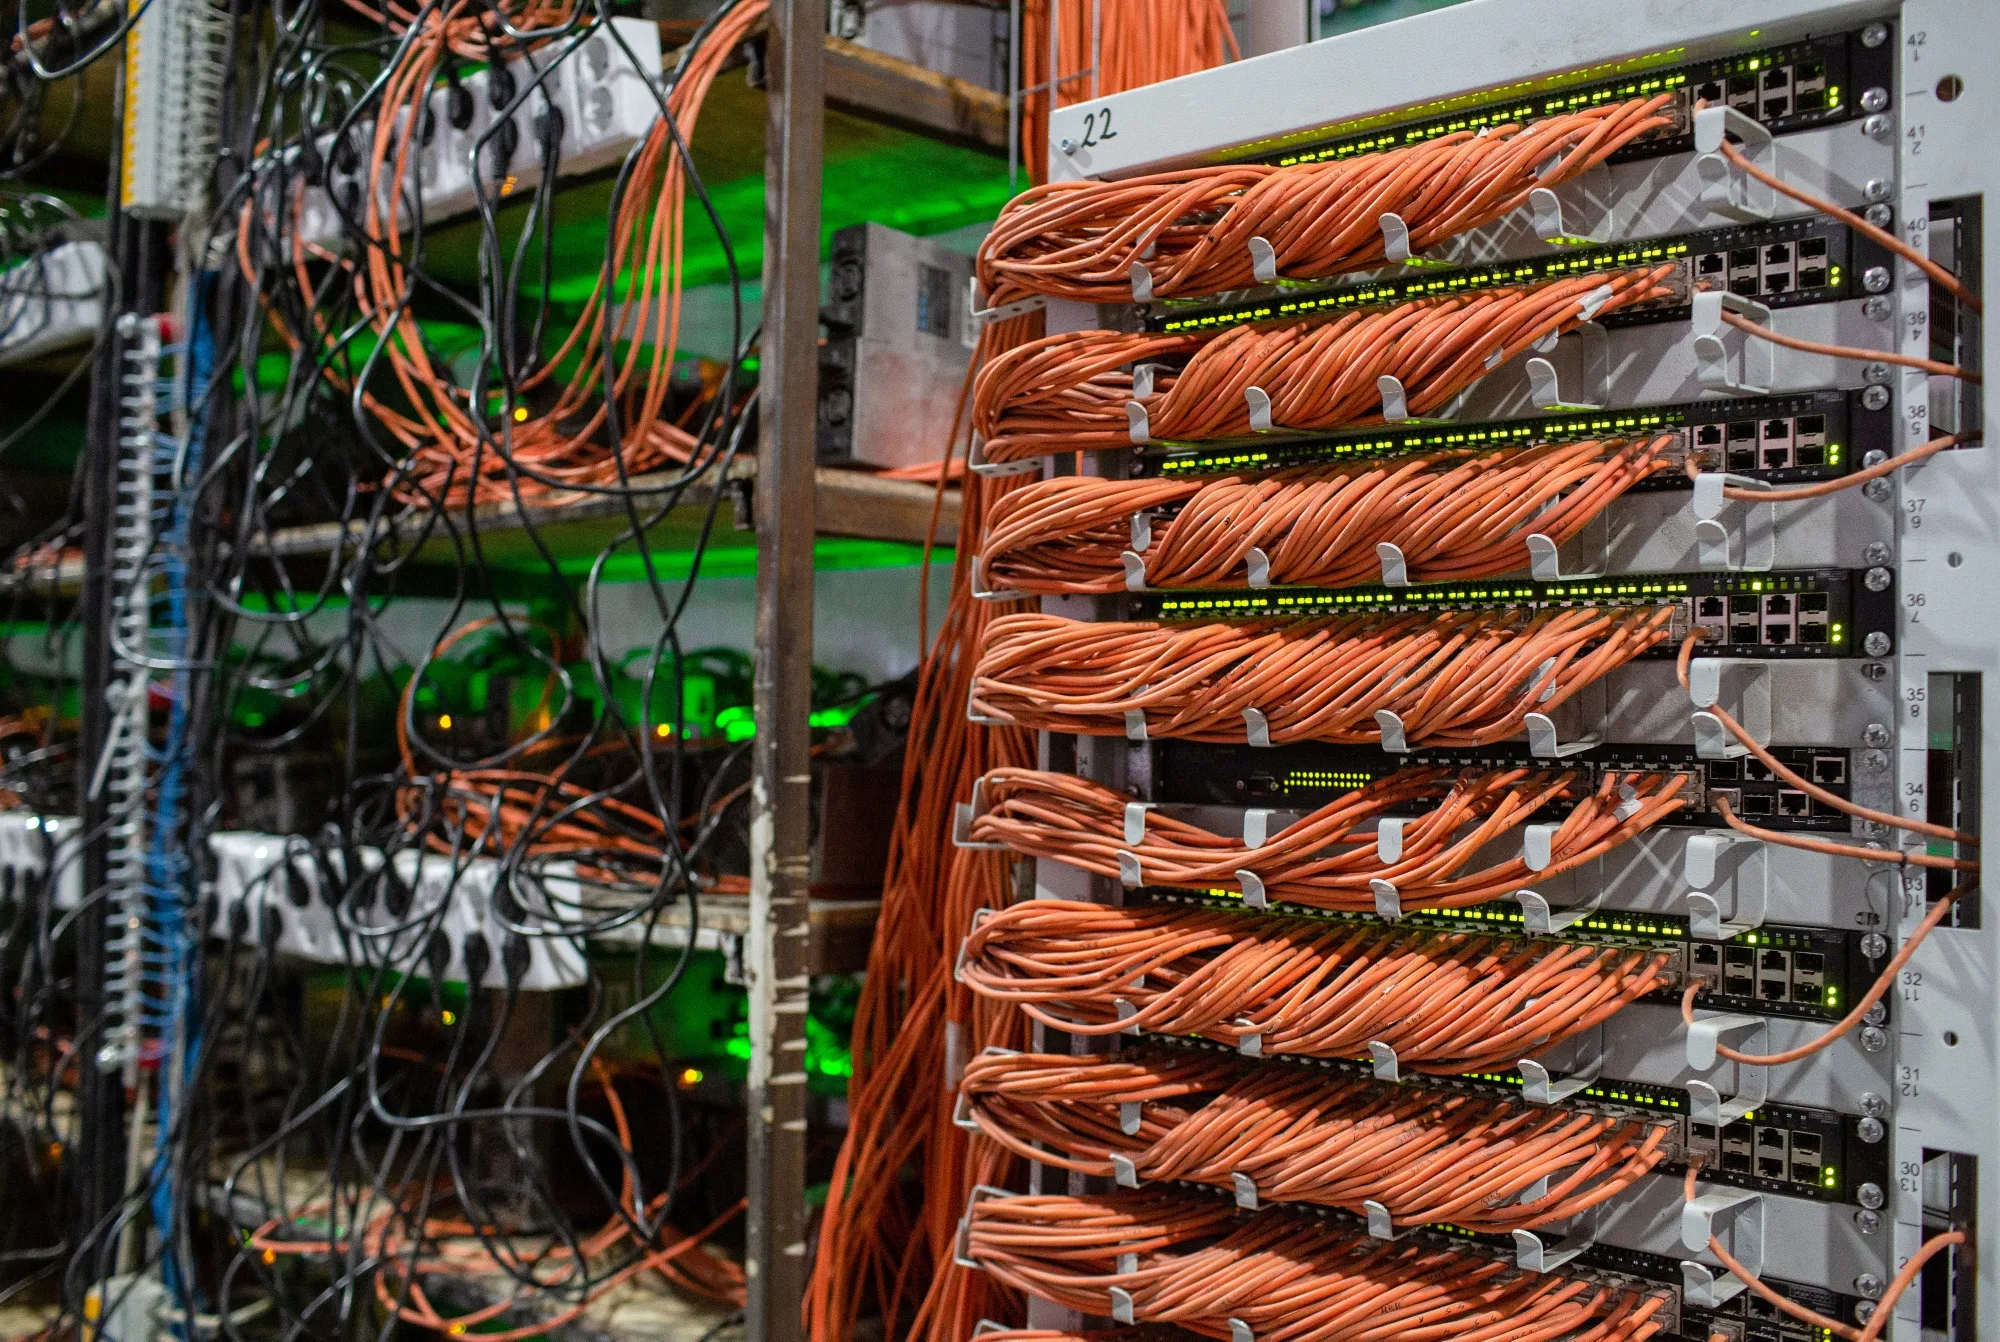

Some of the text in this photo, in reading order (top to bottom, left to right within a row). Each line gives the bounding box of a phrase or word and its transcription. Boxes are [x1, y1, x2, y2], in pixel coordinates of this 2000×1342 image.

[1907, 31, 1927, 46] 42
[1081, 107, 1118, 148] 22
[1907, 124, 1925, 139] 41
[1907, 217, 1927, 231] 40
[1908, 311, 1926, 326] 39
[1908, 404, 1926, 419] 38
[1907, 498, 1927, 513] 37
[1907, 593, 1926, 607] 36
[1906, 687, 1925, 701] 35
[1911, 704, 1920, 717] 8
[1905, 782, 1924, 796] 34
[1903, 971, 1922, 986] 32
[1902, 1066, 1919, 1081] 31
[1901, 1161, 1920, 1177] 30
